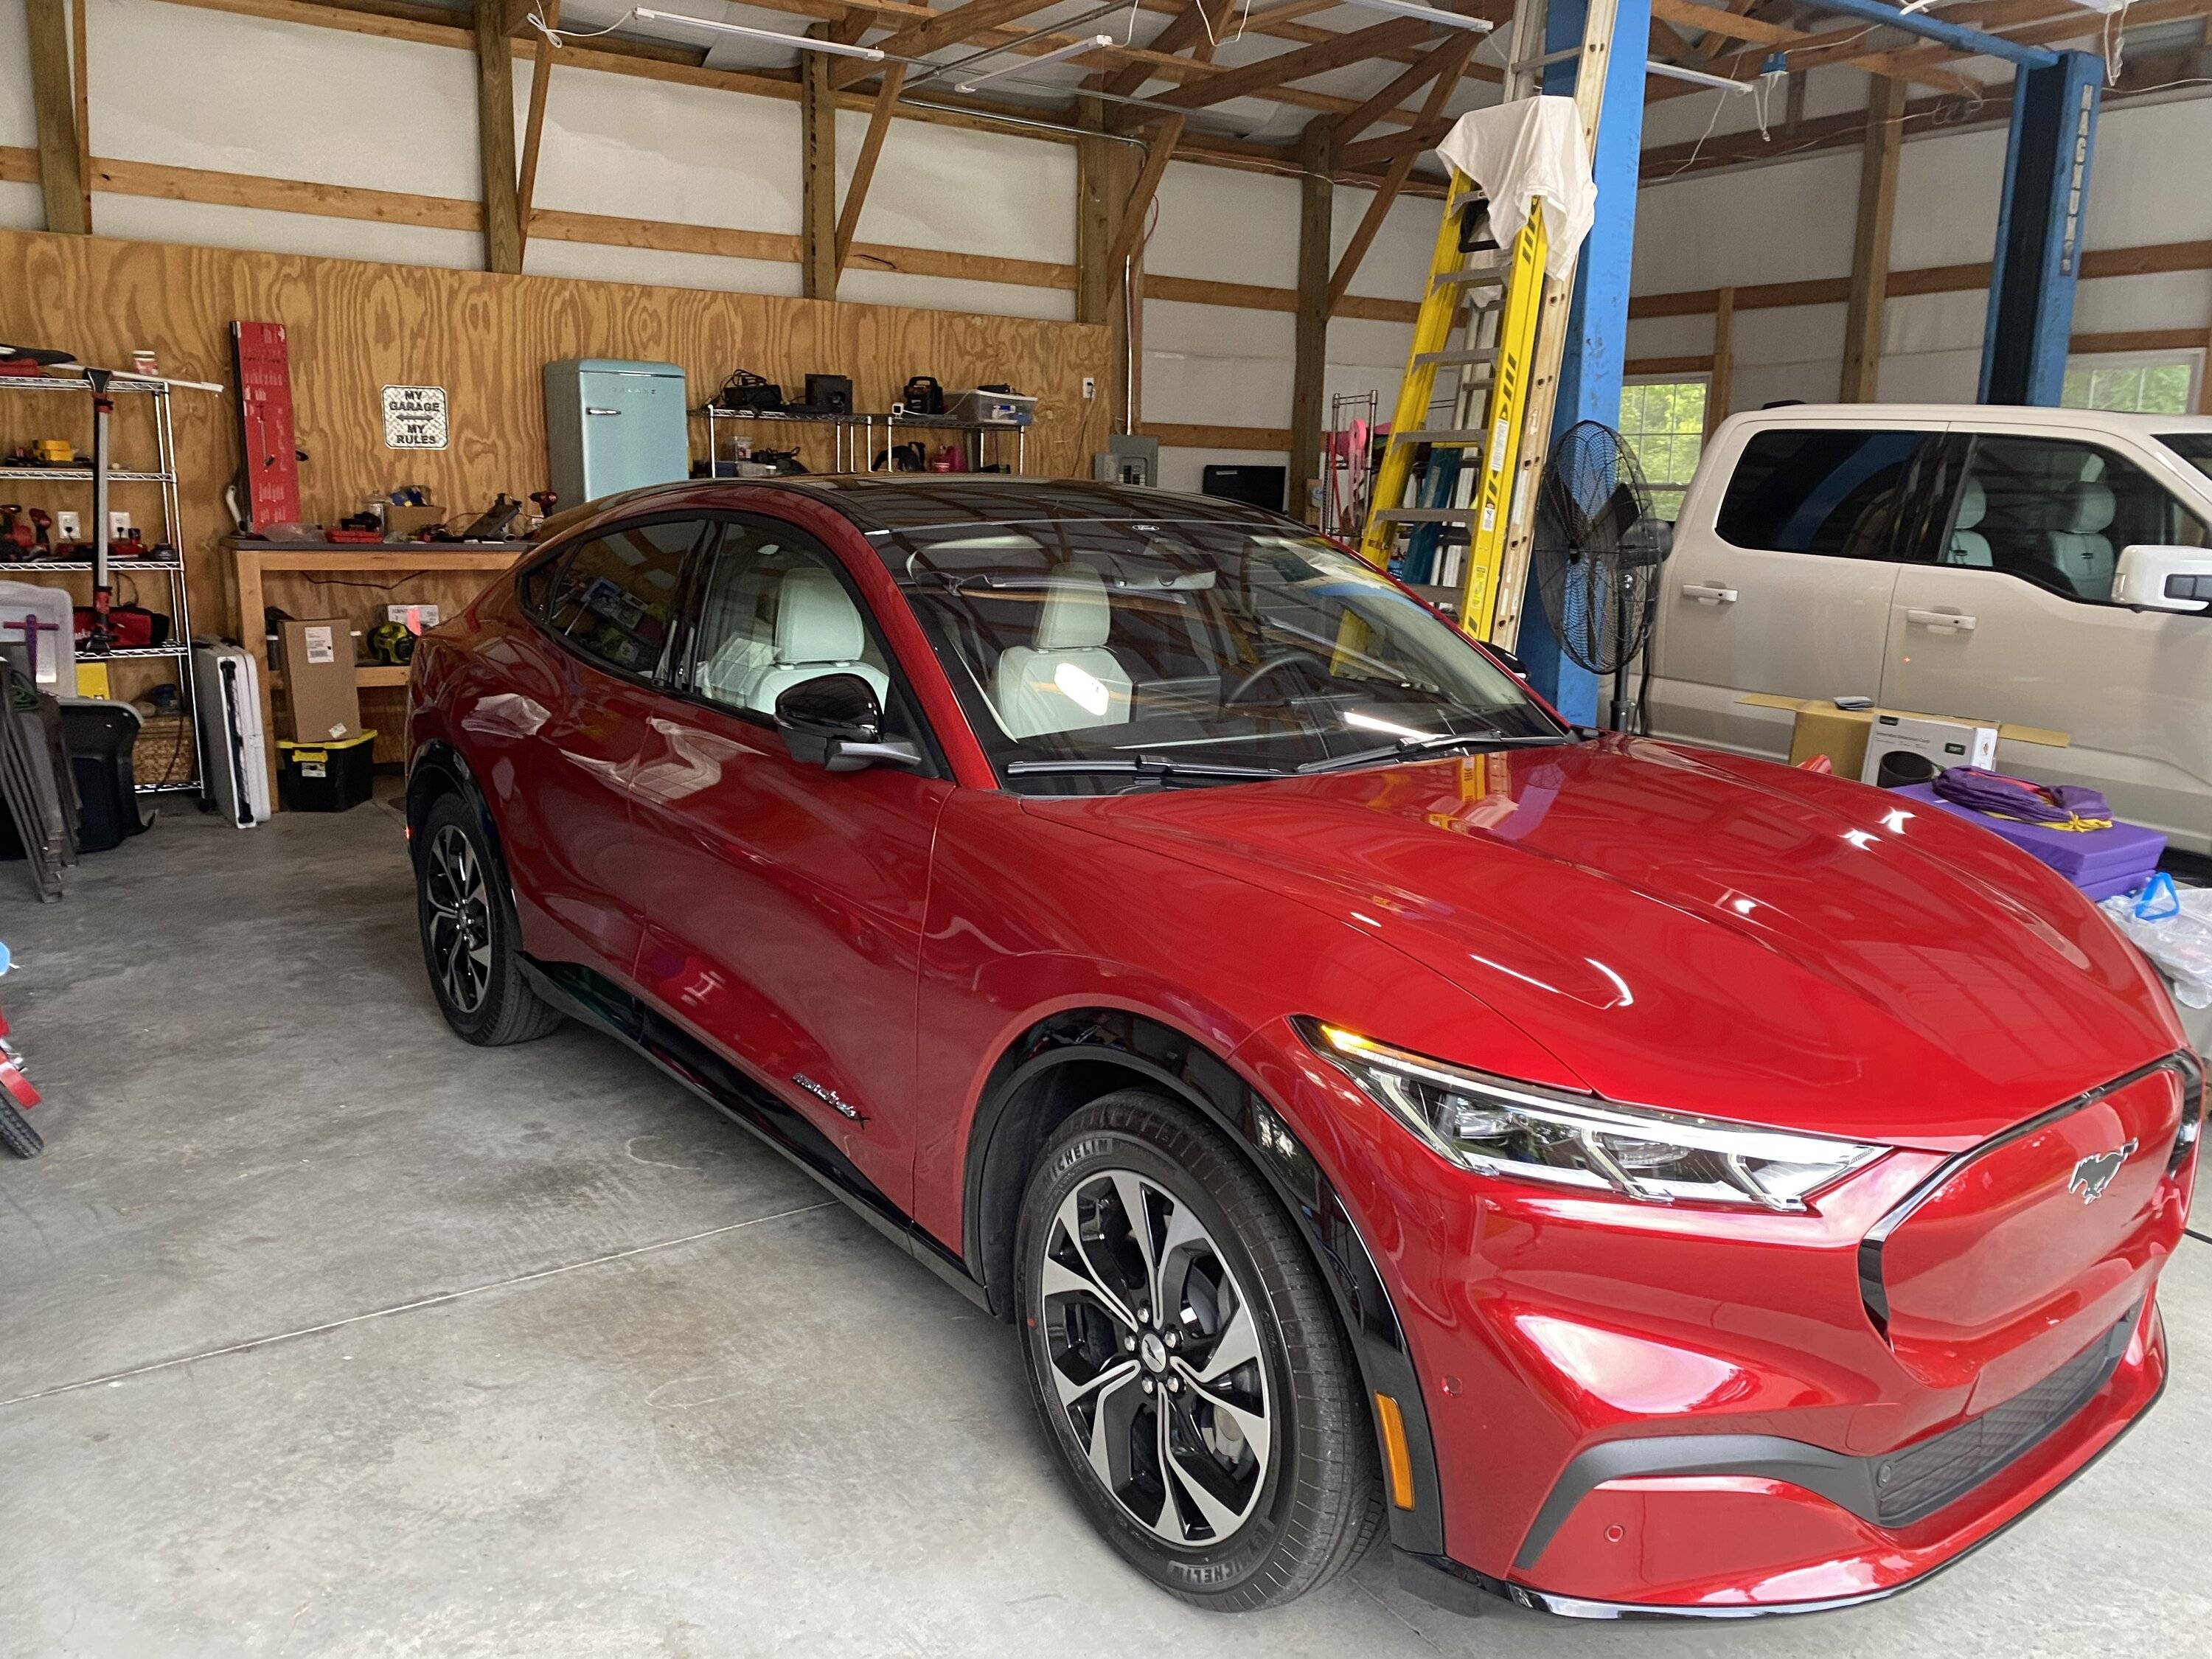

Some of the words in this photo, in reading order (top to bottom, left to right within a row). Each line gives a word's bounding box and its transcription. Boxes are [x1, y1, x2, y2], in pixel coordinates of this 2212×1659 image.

[405, 390, 422, 400] MY
[389, 401, 440, 411] GARAGE
[407, 424, 425, 434] MY
[396, 434, 437, 444] RULES
